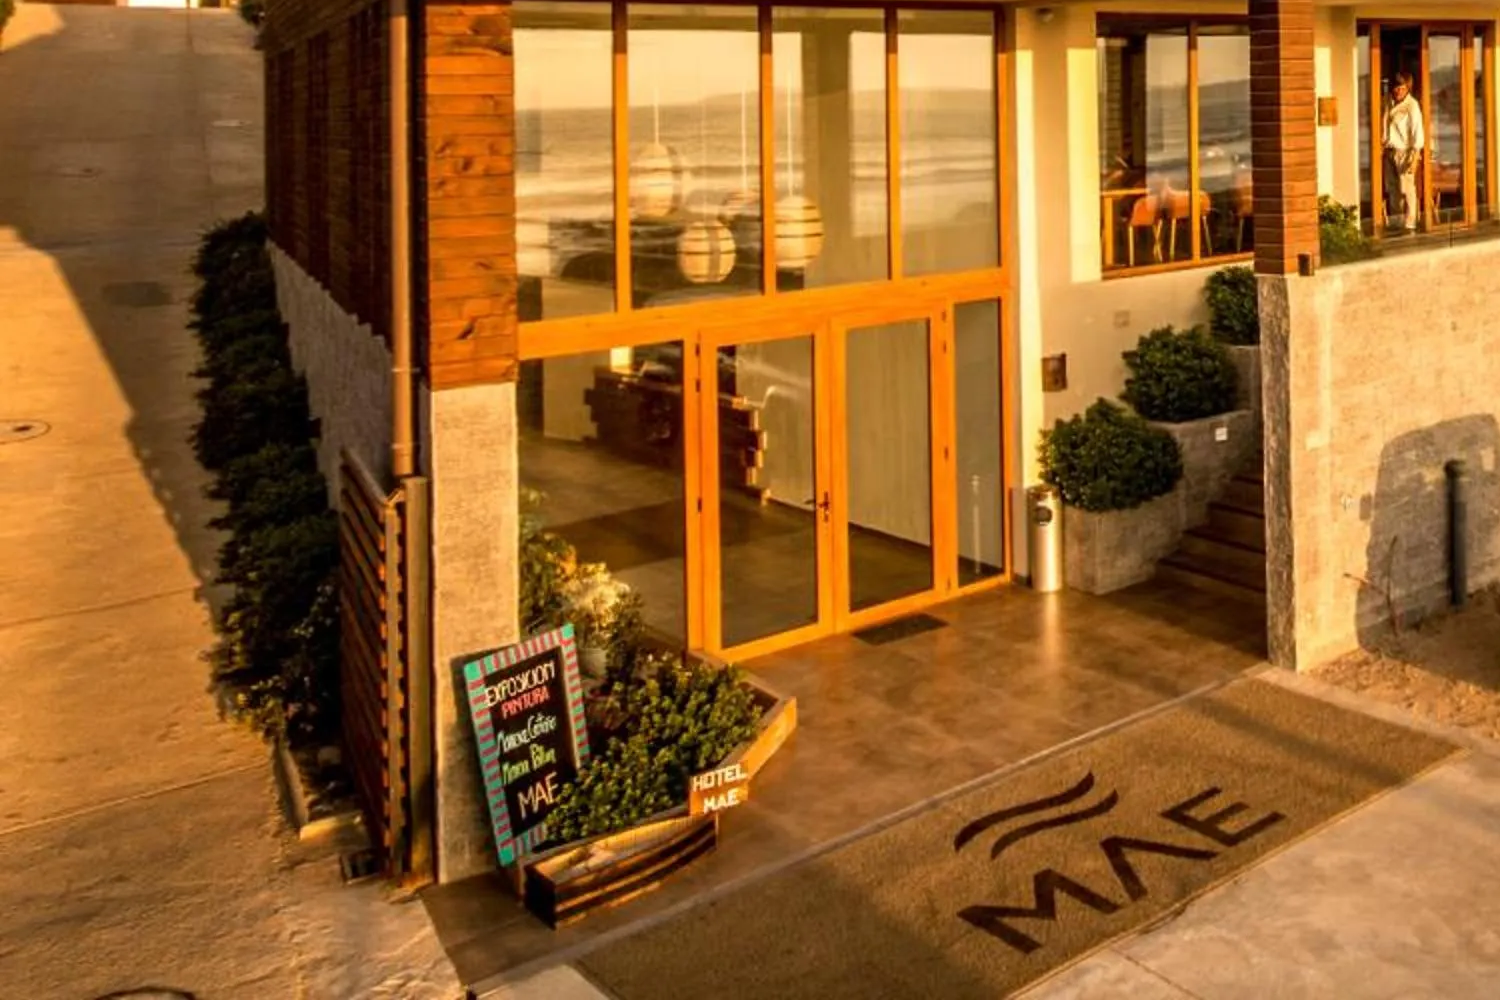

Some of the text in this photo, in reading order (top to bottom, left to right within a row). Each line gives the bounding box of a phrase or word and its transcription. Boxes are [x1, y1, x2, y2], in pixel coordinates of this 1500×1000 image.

[517, 771, 559, 820] MAE
[692, 763, 748, 792] HOTEL
[703, 787, 741, 814] MAE
[957, 786, 1288, 955] MAE
